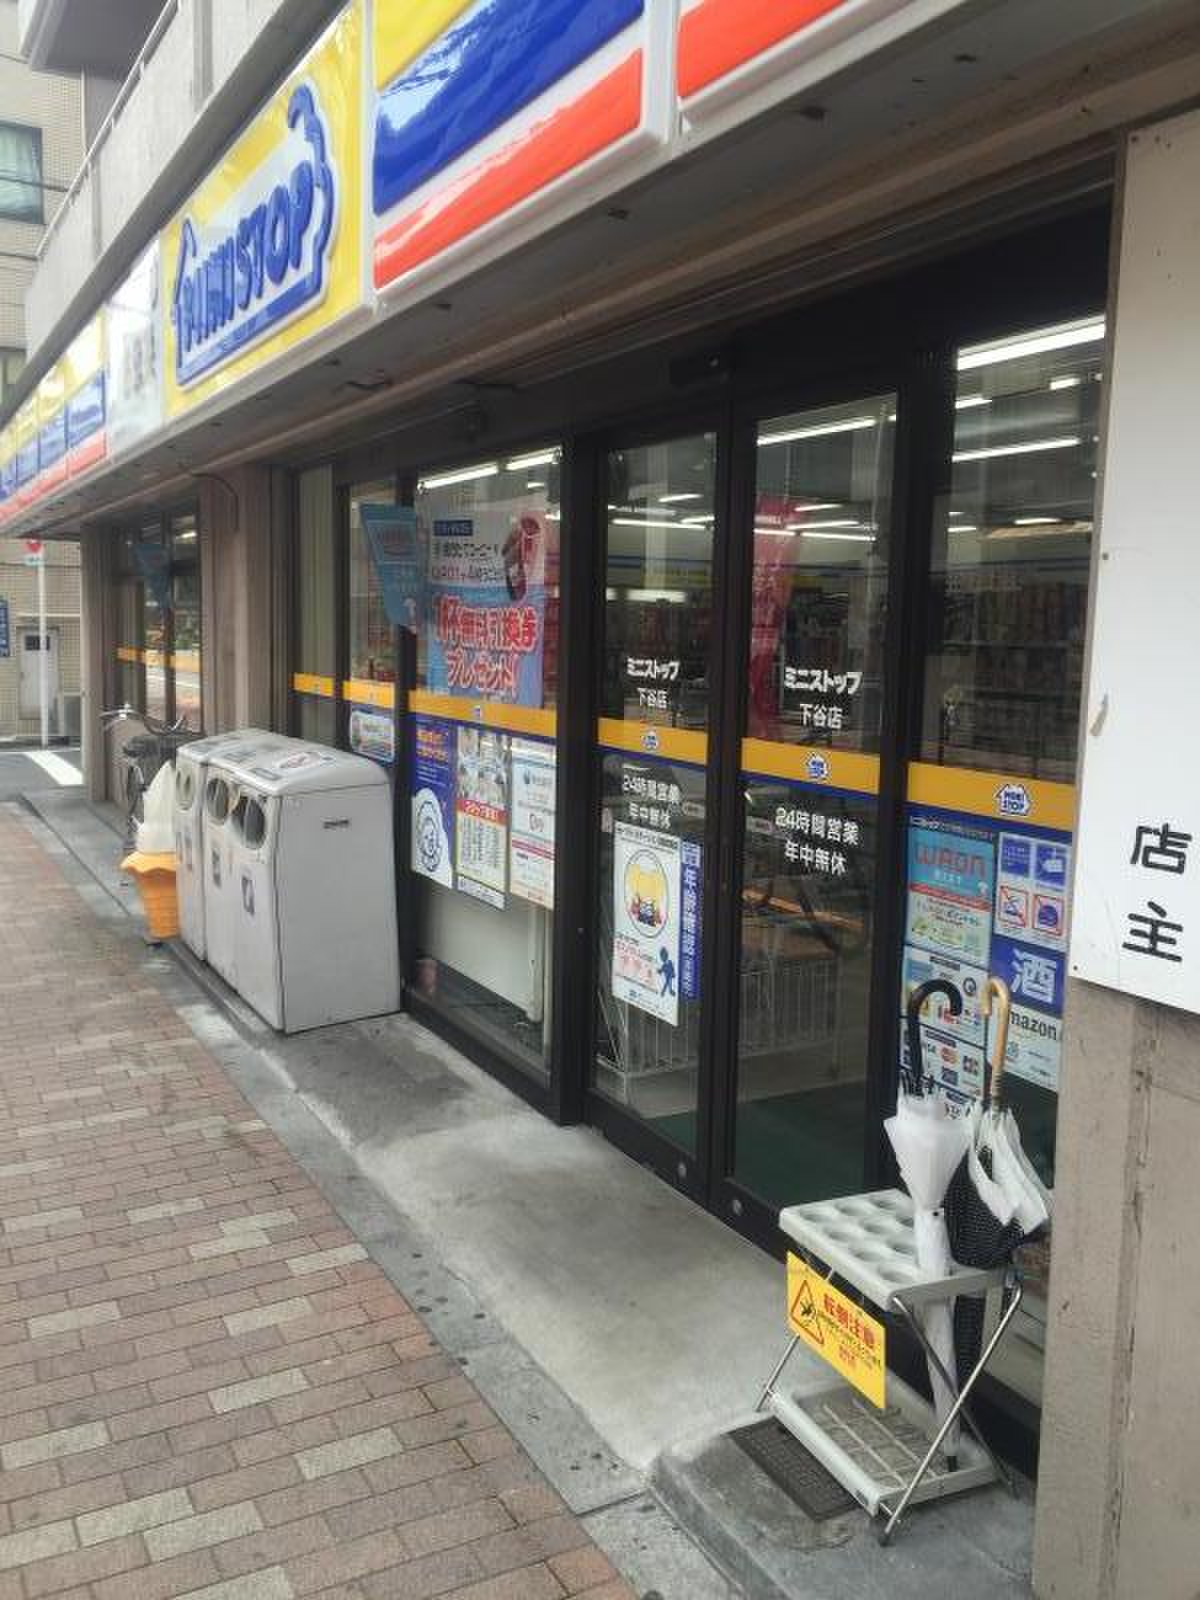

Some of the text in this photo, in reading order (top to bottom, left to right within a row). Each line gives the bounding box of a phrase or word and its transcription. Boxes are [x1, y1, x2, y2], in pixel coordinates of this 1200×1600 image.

[627, 658, 681, 681] ミニストップ
[784, 667, 863, 695] ミニストップ
[799, 703, 844, 730] 下谷店
[775, 807, 860, 846] 24時間営業
[783, 839, 847, 876] 年中無休
[1011, 947, 1057, 1004] 酒
[1008, 1010, 1057, 1041] mazon
